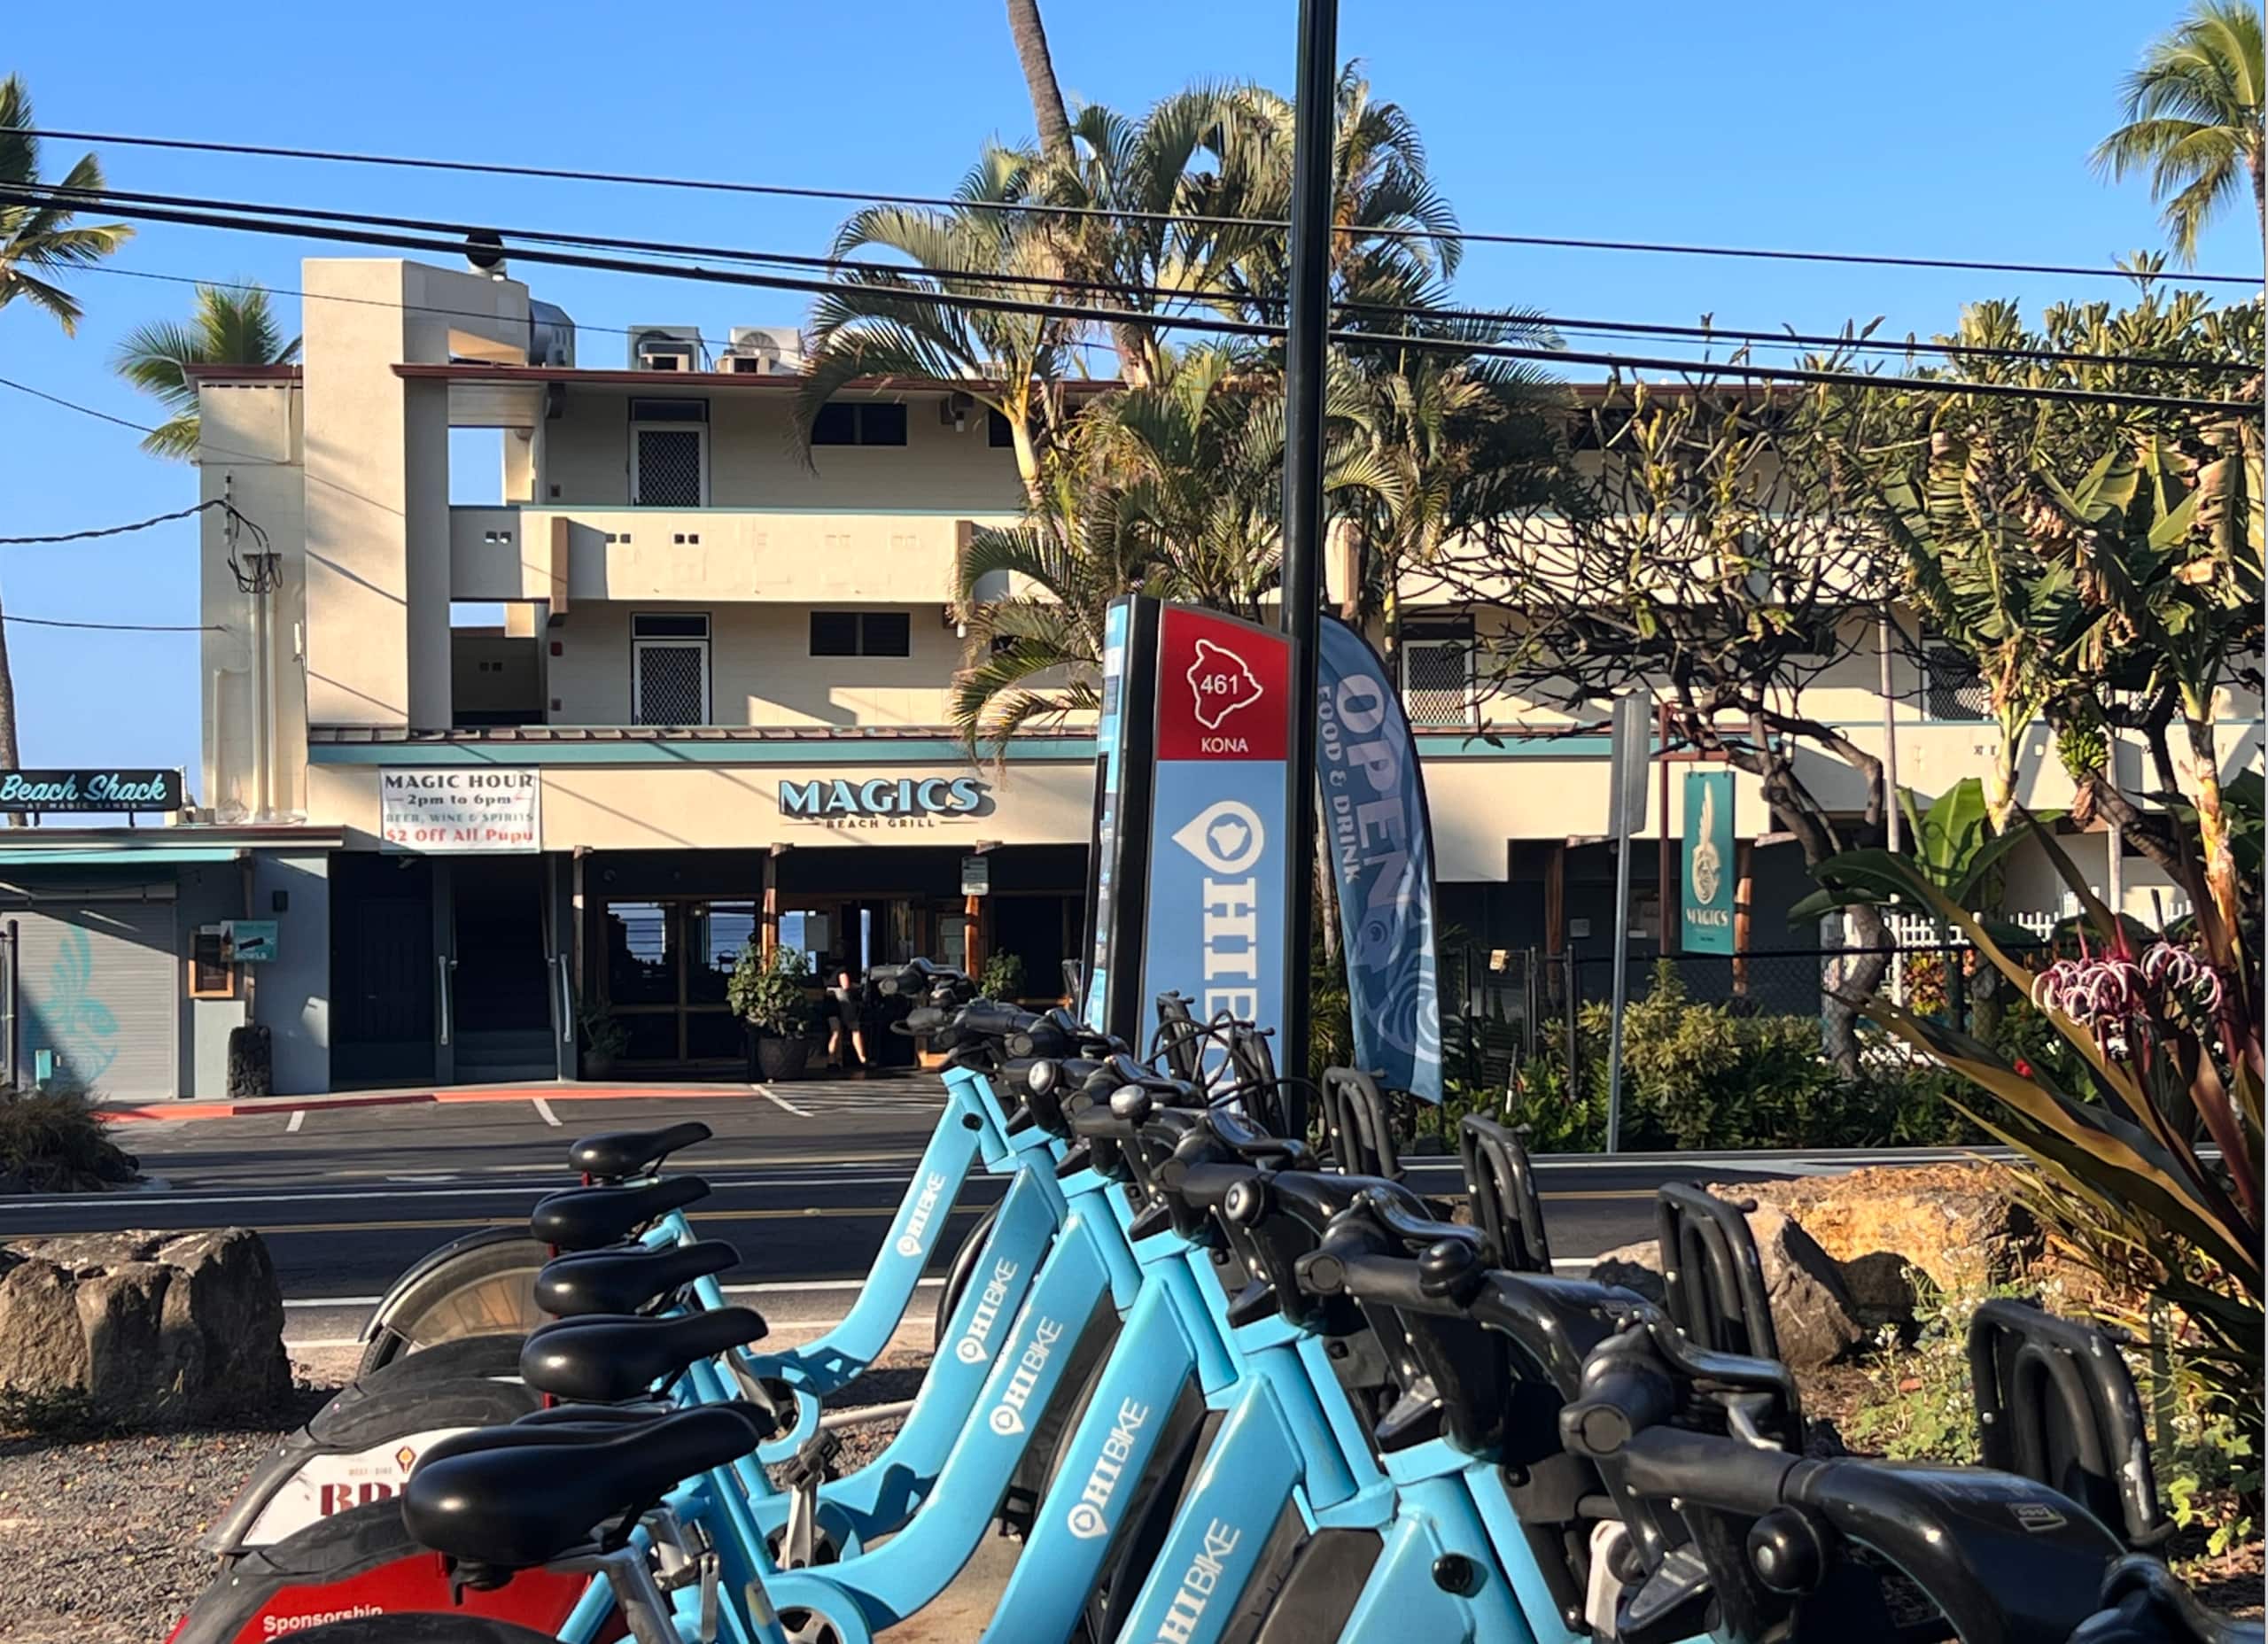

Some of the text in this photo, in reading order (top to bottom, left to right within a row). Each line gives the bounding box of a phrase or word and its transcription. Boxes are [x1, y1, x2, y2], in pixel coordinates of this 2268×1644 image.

[1200, 672, 1240, 696] 461
[1200, 737, 1249, 754] KONA
[0, 772, 167, 802] Beach Shack
[384, 773, 533, 789] MAGIC HOUR
[1329, 769, 1346, 787] &
[1335, 672, 1420, 910] OPEN
[407, 794, 512, 808] 2pm to 6pm
[779, 776, 983, 815] MAGICS
[429, 813, 462, 823] WINE
[483, 812, 534, 823] SPIRITS
[825, 818, 936, 829] BEACH GRILL
[385, 828, 534, 844] $2 Off All Pupu
[1332, 796, 1361, 884] DRINK
[1686, 908, 1728, 927] MAGICS
[908, 1171, 946, 1239] HIBIKE
[967, 1257, 1018, 1342] HIBIKE
[1005, 1315, 1063, 1412] HIBIKE
[1082, 1396, 1149, 1509] HIBIKE
[1157, 1517, 1241, 1644] HIBIKE
